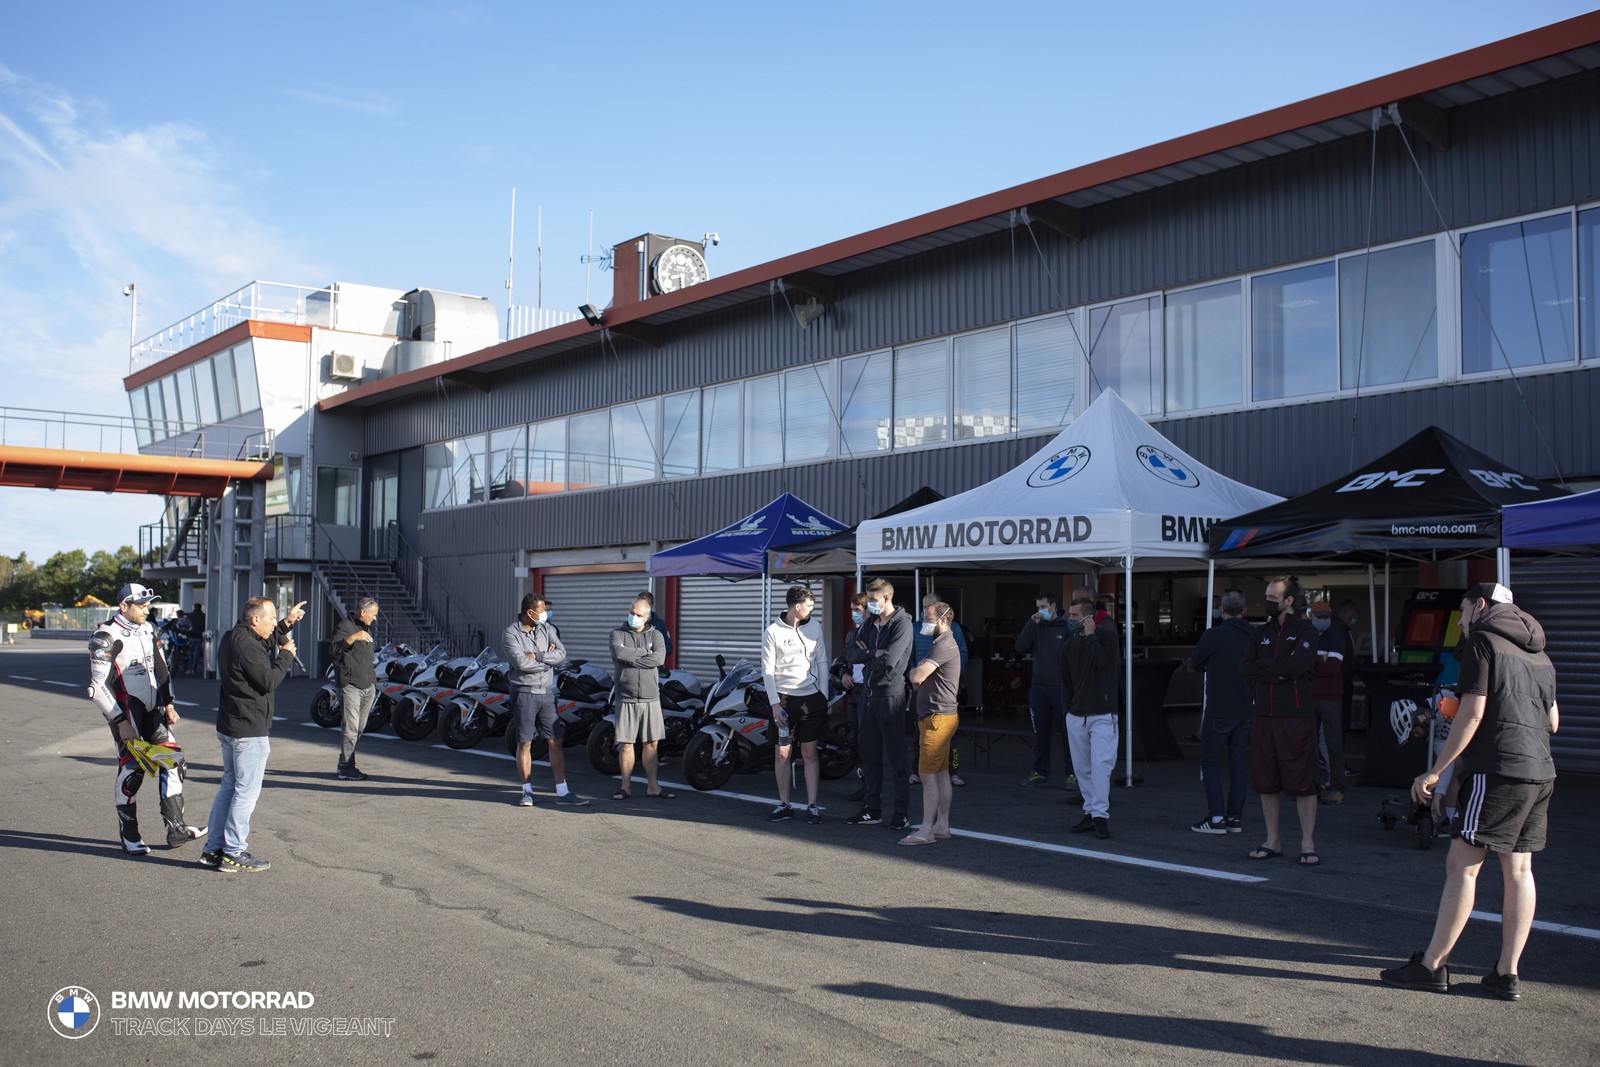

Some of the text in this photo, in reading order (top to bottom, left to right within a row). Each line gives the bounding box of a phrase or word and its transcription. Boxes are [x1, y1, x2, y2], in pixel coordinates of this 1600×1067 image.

[1335, 468, 1446, 493] BMC
[881, 515, 1092, 550] BMW MOTORRAD
[1391, 524, 1477, 535] bmc-moto.com
